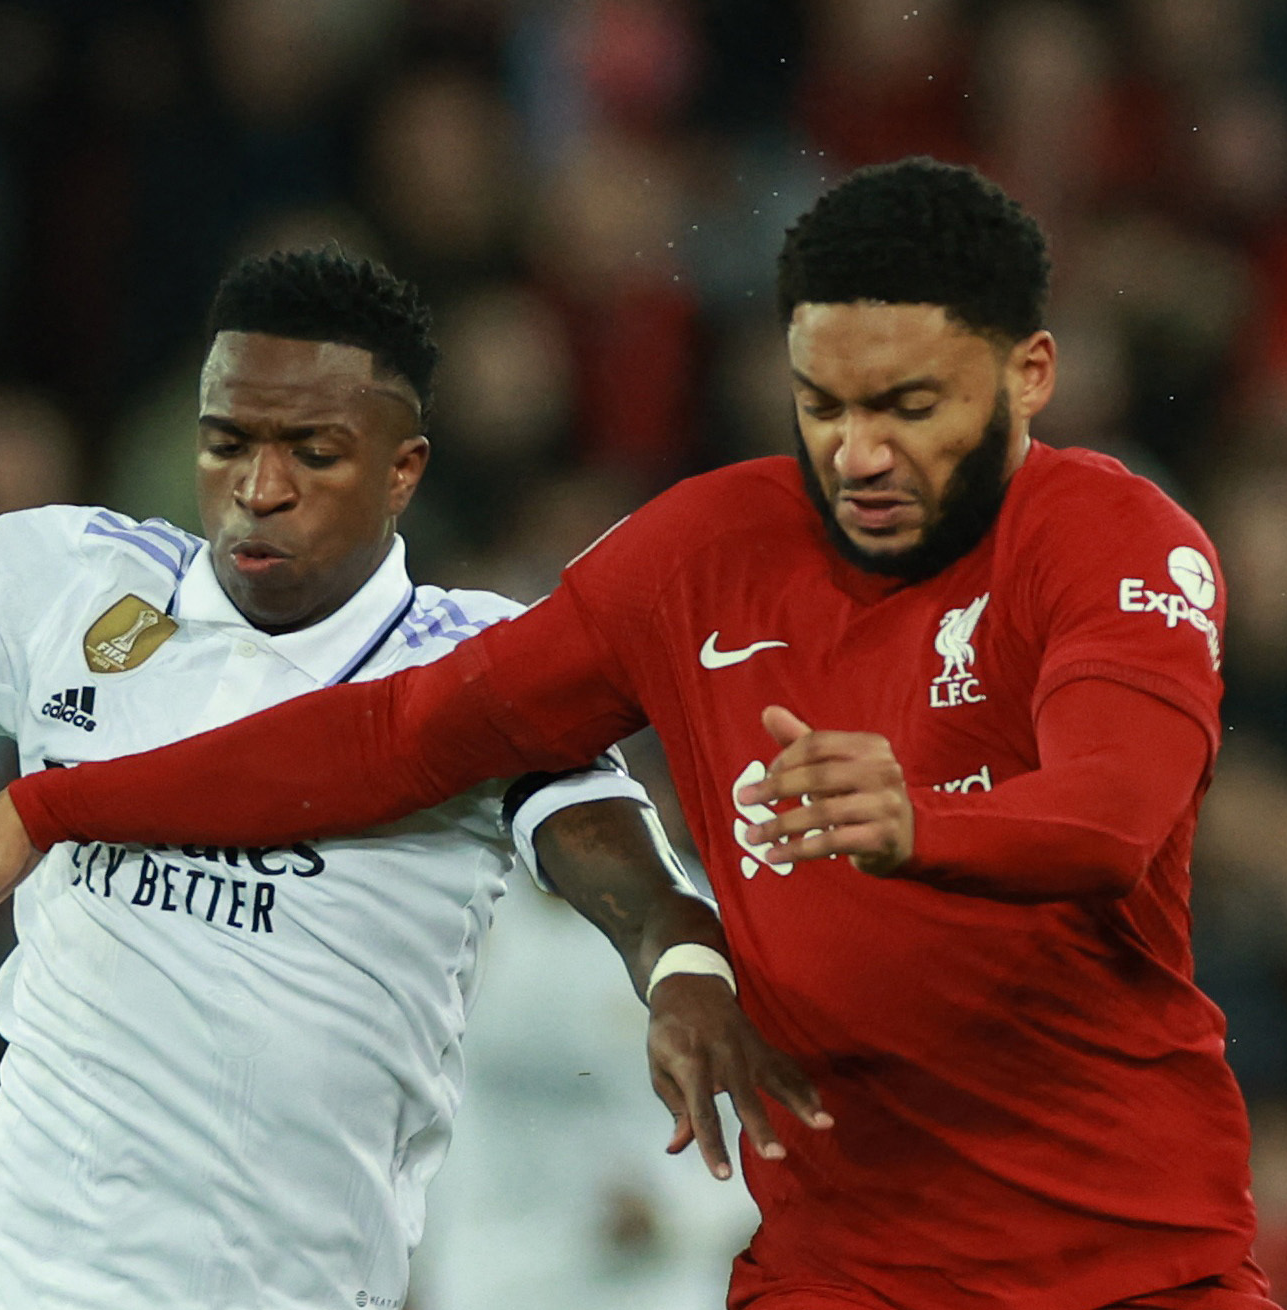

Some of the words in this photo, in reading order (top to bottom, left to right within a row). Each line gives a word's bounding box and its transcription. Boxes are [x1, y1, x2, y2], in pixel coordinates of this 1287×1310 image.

[97, 641, 128, 664] FIFA
[41, 702, 97, 732] adidas
[131, 854, 275, 933] BETTER
